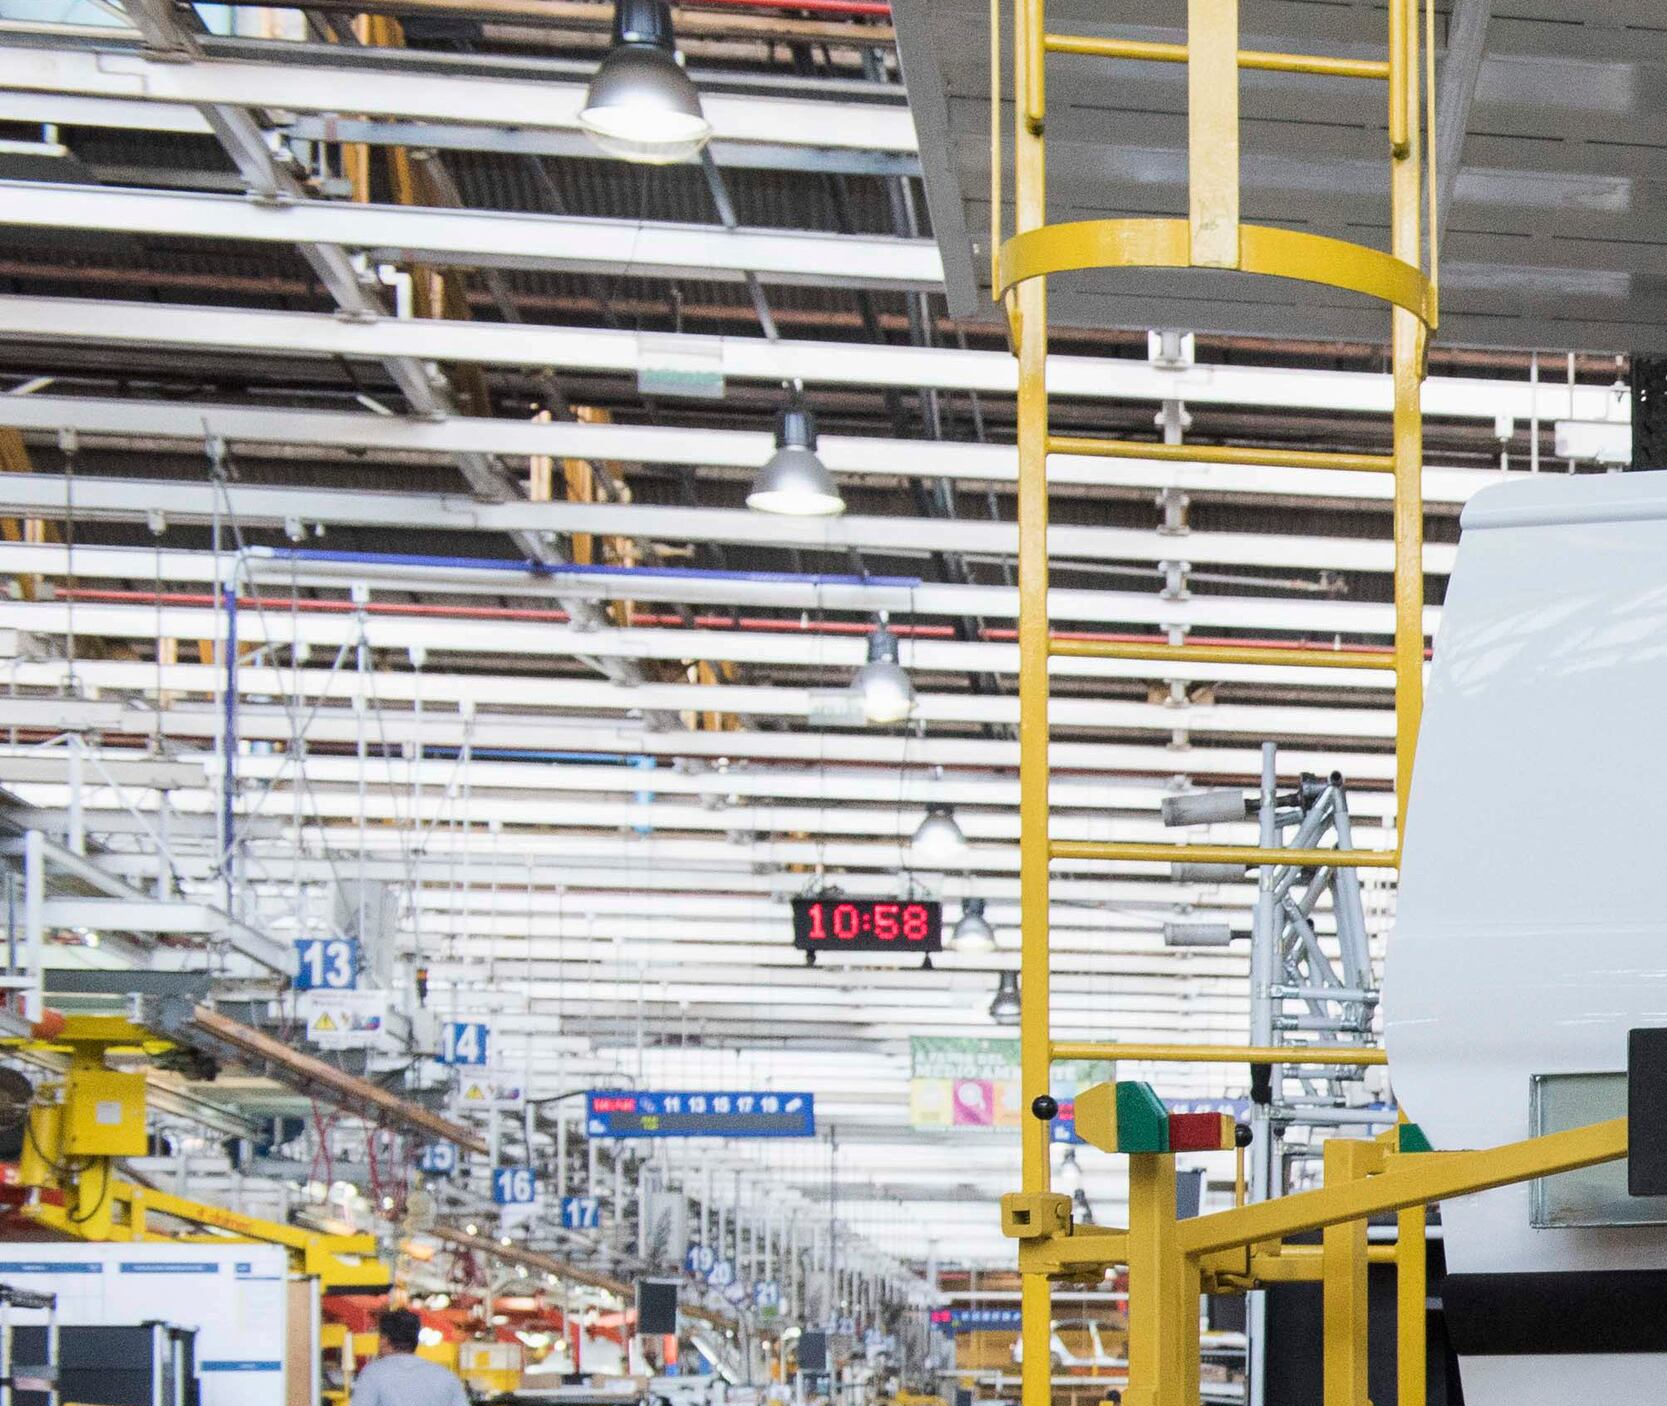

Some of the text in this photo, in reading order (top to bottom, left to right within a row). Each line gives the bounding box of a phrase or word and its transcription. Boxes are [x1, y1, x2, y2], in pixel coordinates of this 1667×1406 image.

[808, 903, 928, 940] 10:58
[304, 941, 350, 987] 13
[443, 1024, 478, 1063] 14
[664, 1097, 681, 1113] 11
[423, 1145, 452, 1169] 15
[499, 1170, 531, 1201] 16
[567, 1199, 598, 1227] 17
[688, 1246, 714, 1271] 19
